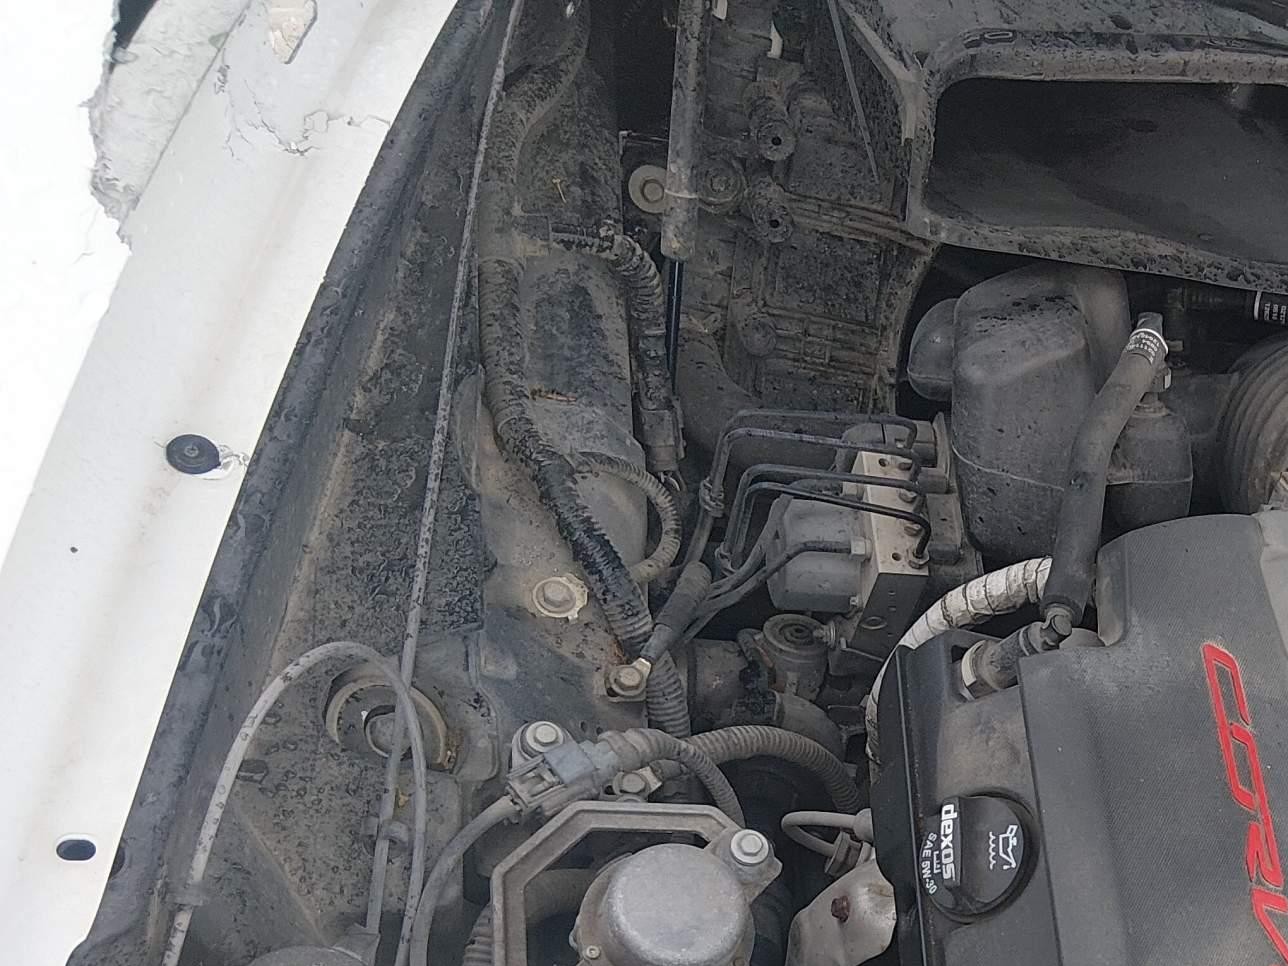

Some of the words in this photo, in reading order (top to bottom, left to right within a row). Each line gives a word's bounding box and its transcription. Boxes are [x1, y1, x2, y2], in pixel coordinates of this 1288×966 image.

[922, 832, 938, 858] SAE
[940, 803, 958, 881] dexos
[921, 860, 938, 895] 5W-30
